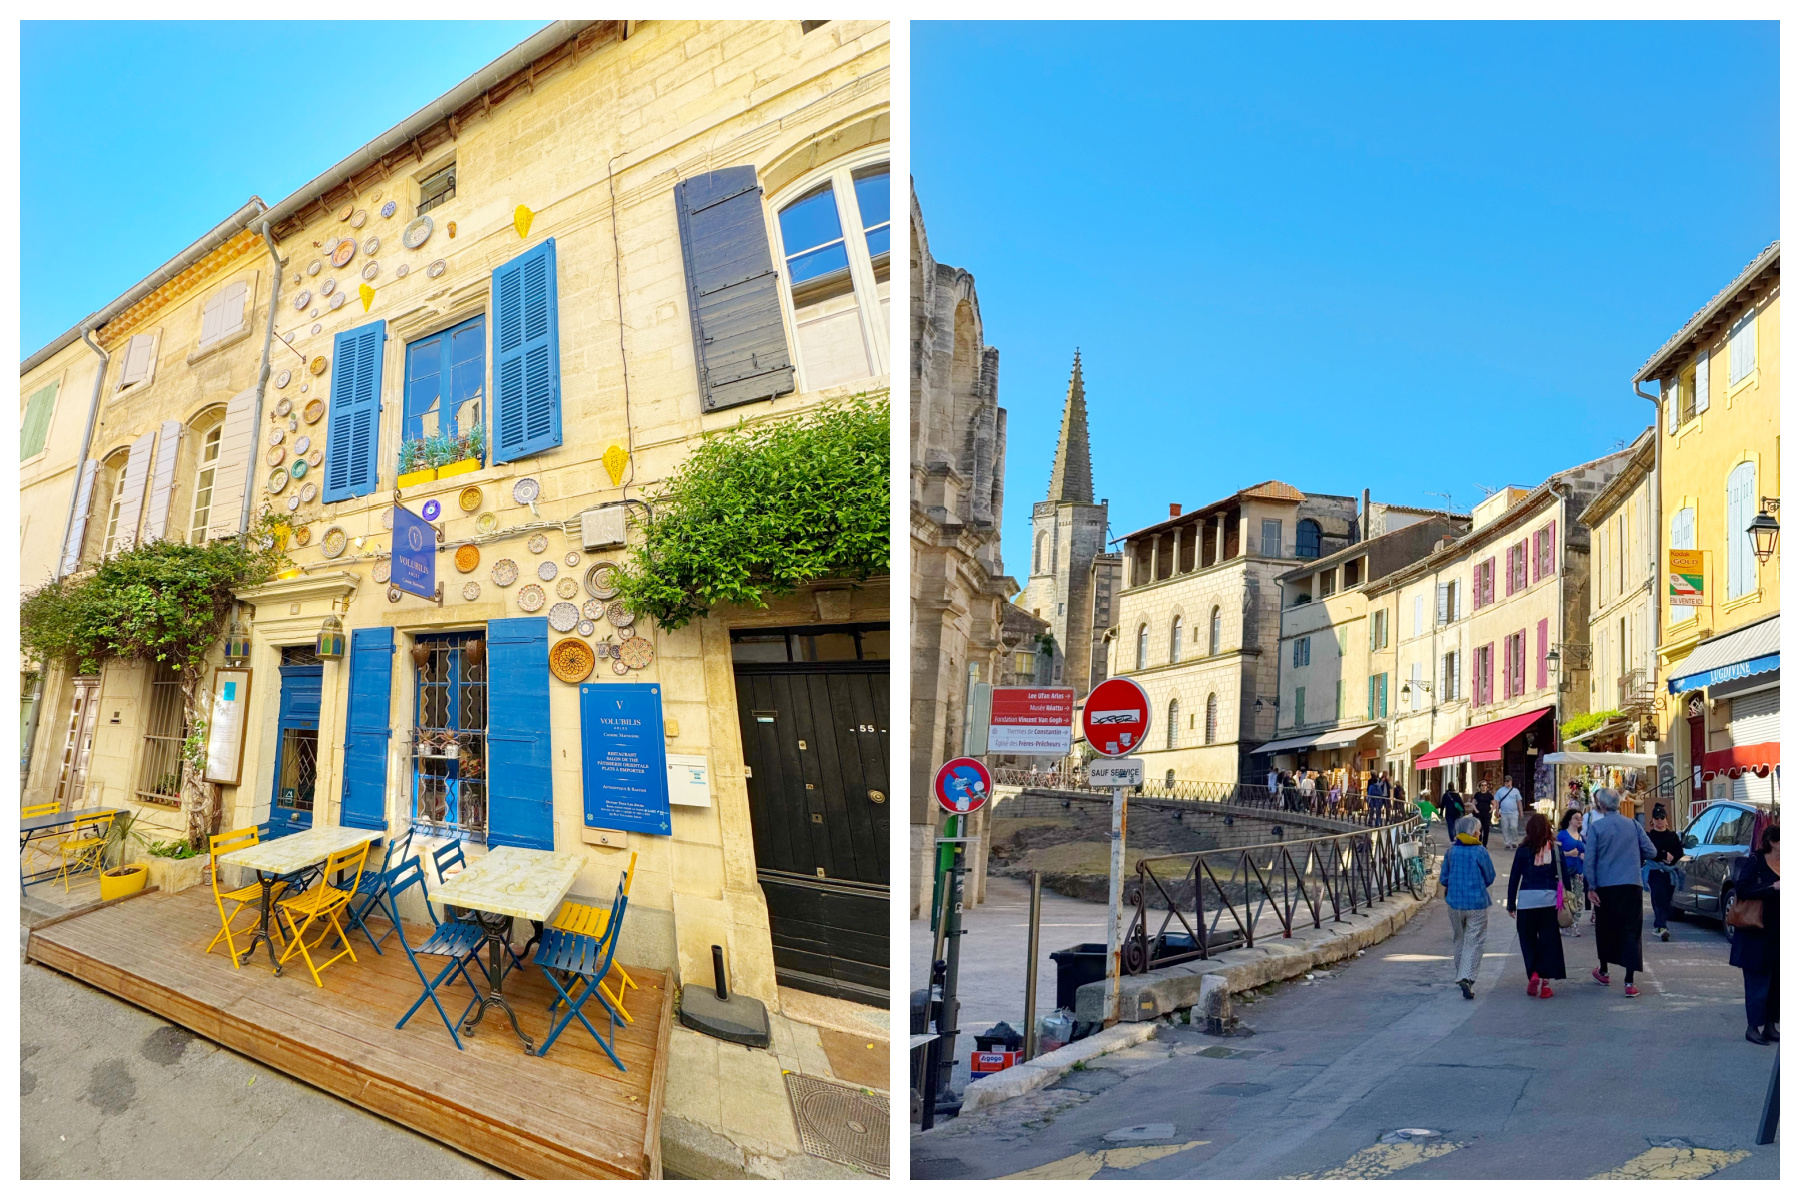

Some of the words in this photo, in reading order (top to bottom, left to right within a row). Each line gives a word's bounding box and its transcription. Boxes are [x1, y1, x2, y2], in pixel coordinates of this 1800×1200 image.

[413, 532, 419, 544] V
[400, 555, 429, 574] VOLUBILIS
[1711, 662, 1750, 681] LUGDIVINE
[616, 700, 624, 709] V
